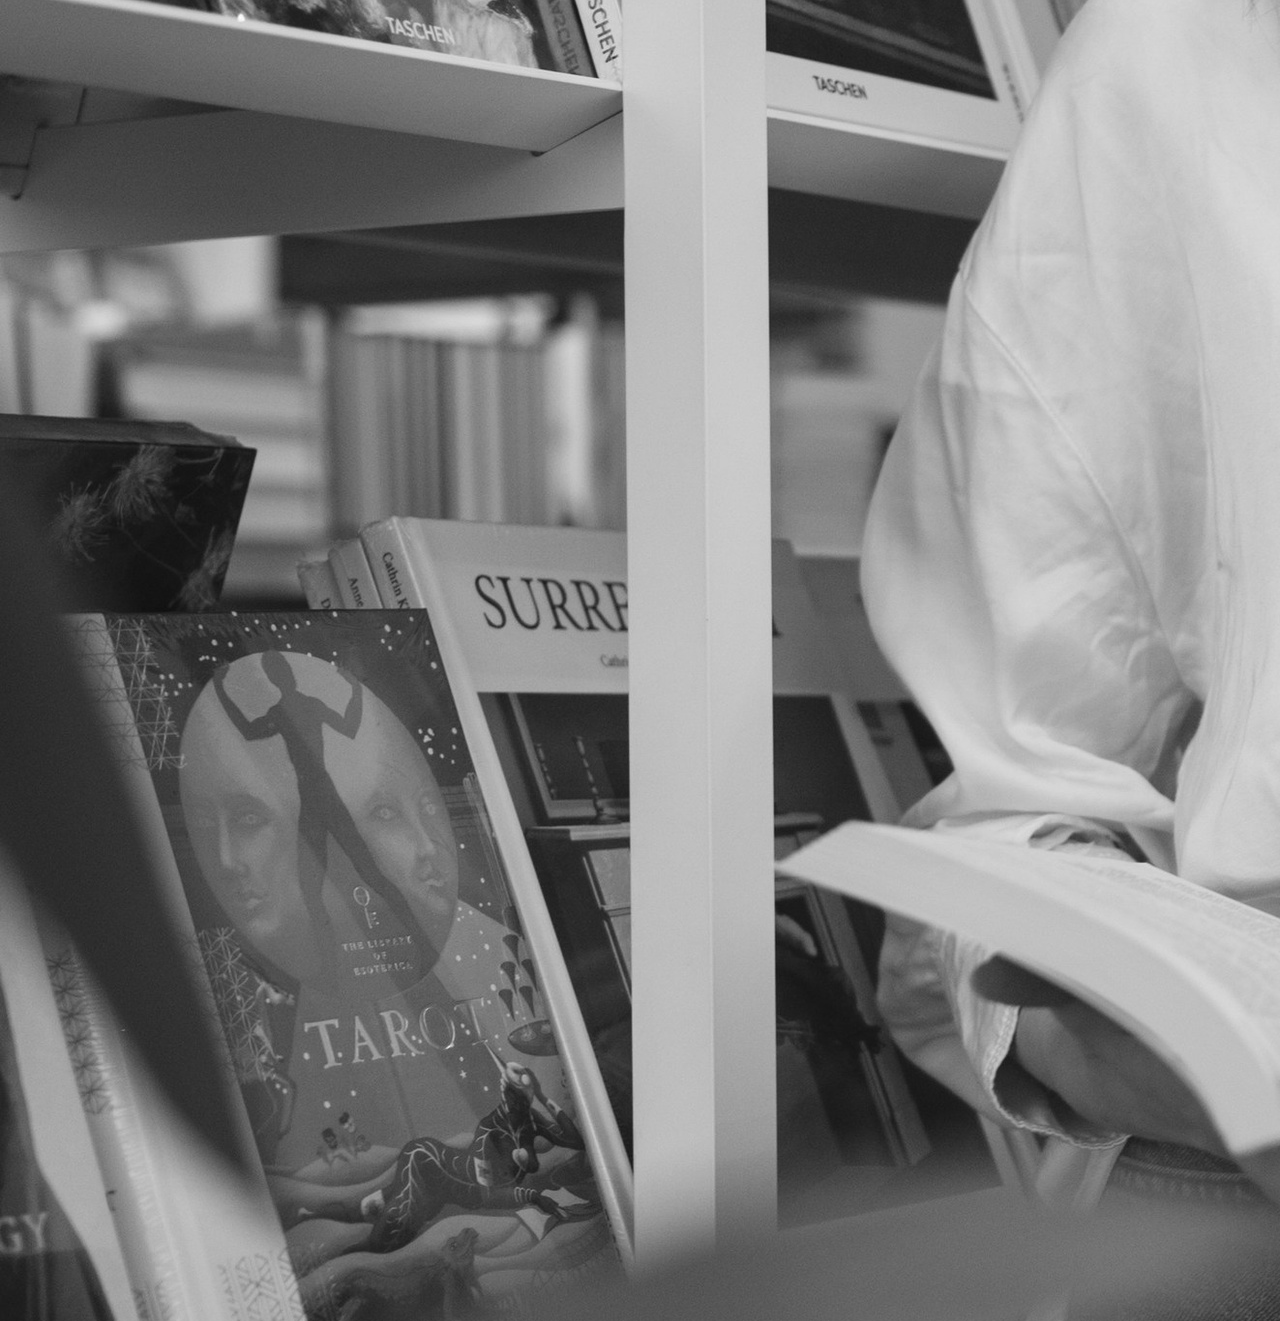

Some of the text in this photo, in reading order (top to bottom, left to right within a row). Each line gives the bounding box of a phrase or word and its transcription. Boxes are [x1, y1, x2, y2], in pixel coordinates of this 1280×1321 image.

[385, 16, 455, 45] TASCHEN
[813, 75, 868, 100] TASCHEN
[382, 552, 403, 597] Cathrin
[348, 578, 364, 607] Anne
[342, 940, 365, 952] THE
[304, 997, 488, 1070] TAROT
